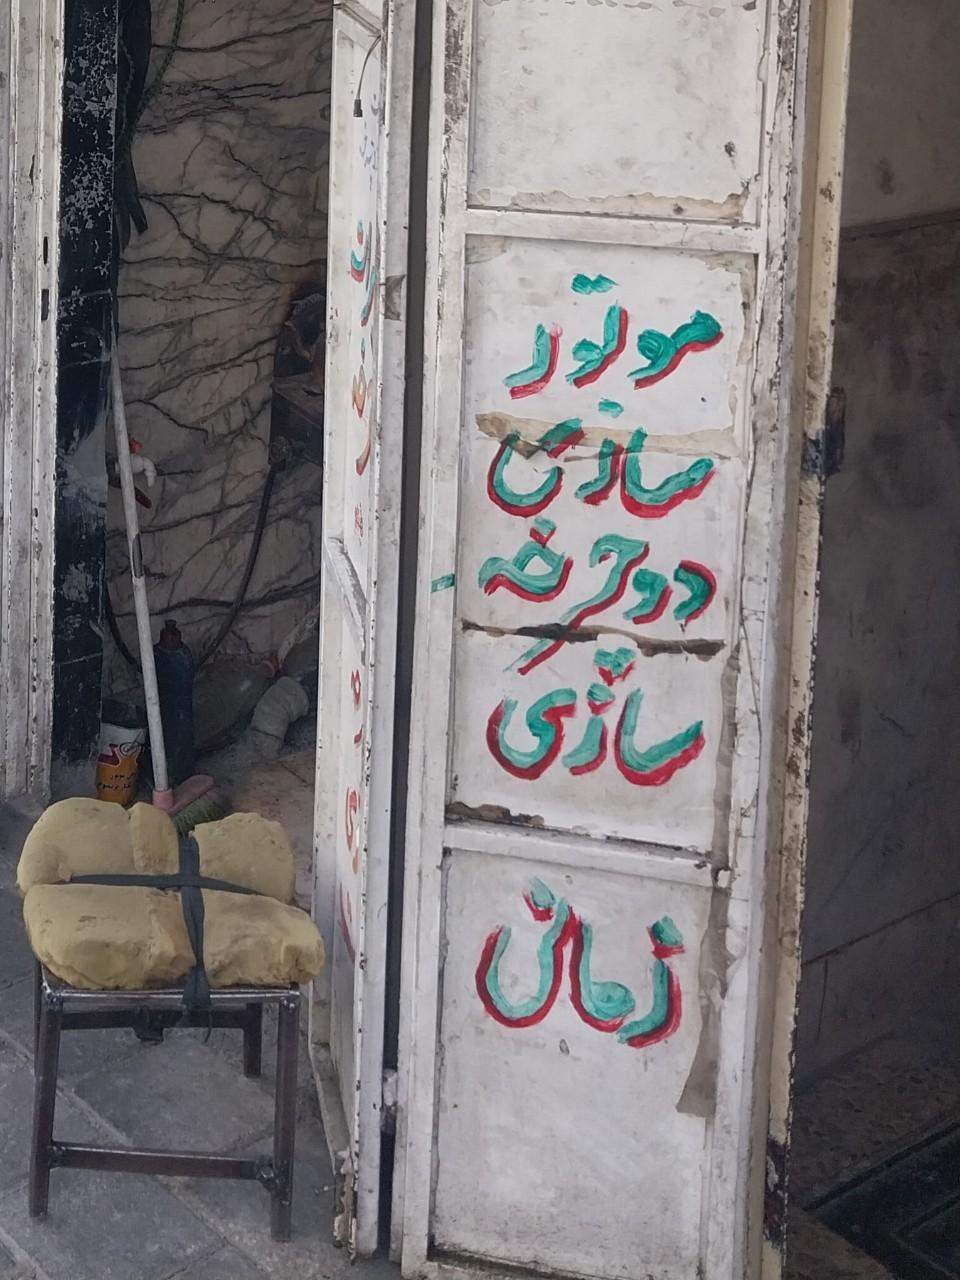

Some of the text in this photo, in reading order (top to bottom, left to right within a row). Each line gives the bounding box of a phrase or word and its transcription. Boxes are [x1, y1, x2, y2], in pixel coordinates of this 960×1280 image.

[503, 273, 724, 401] موتور
[487, 398, 716, 519] سازی
[486, 680, 706, 787] سازی
[474, 876, 684, 1049] زمانی
